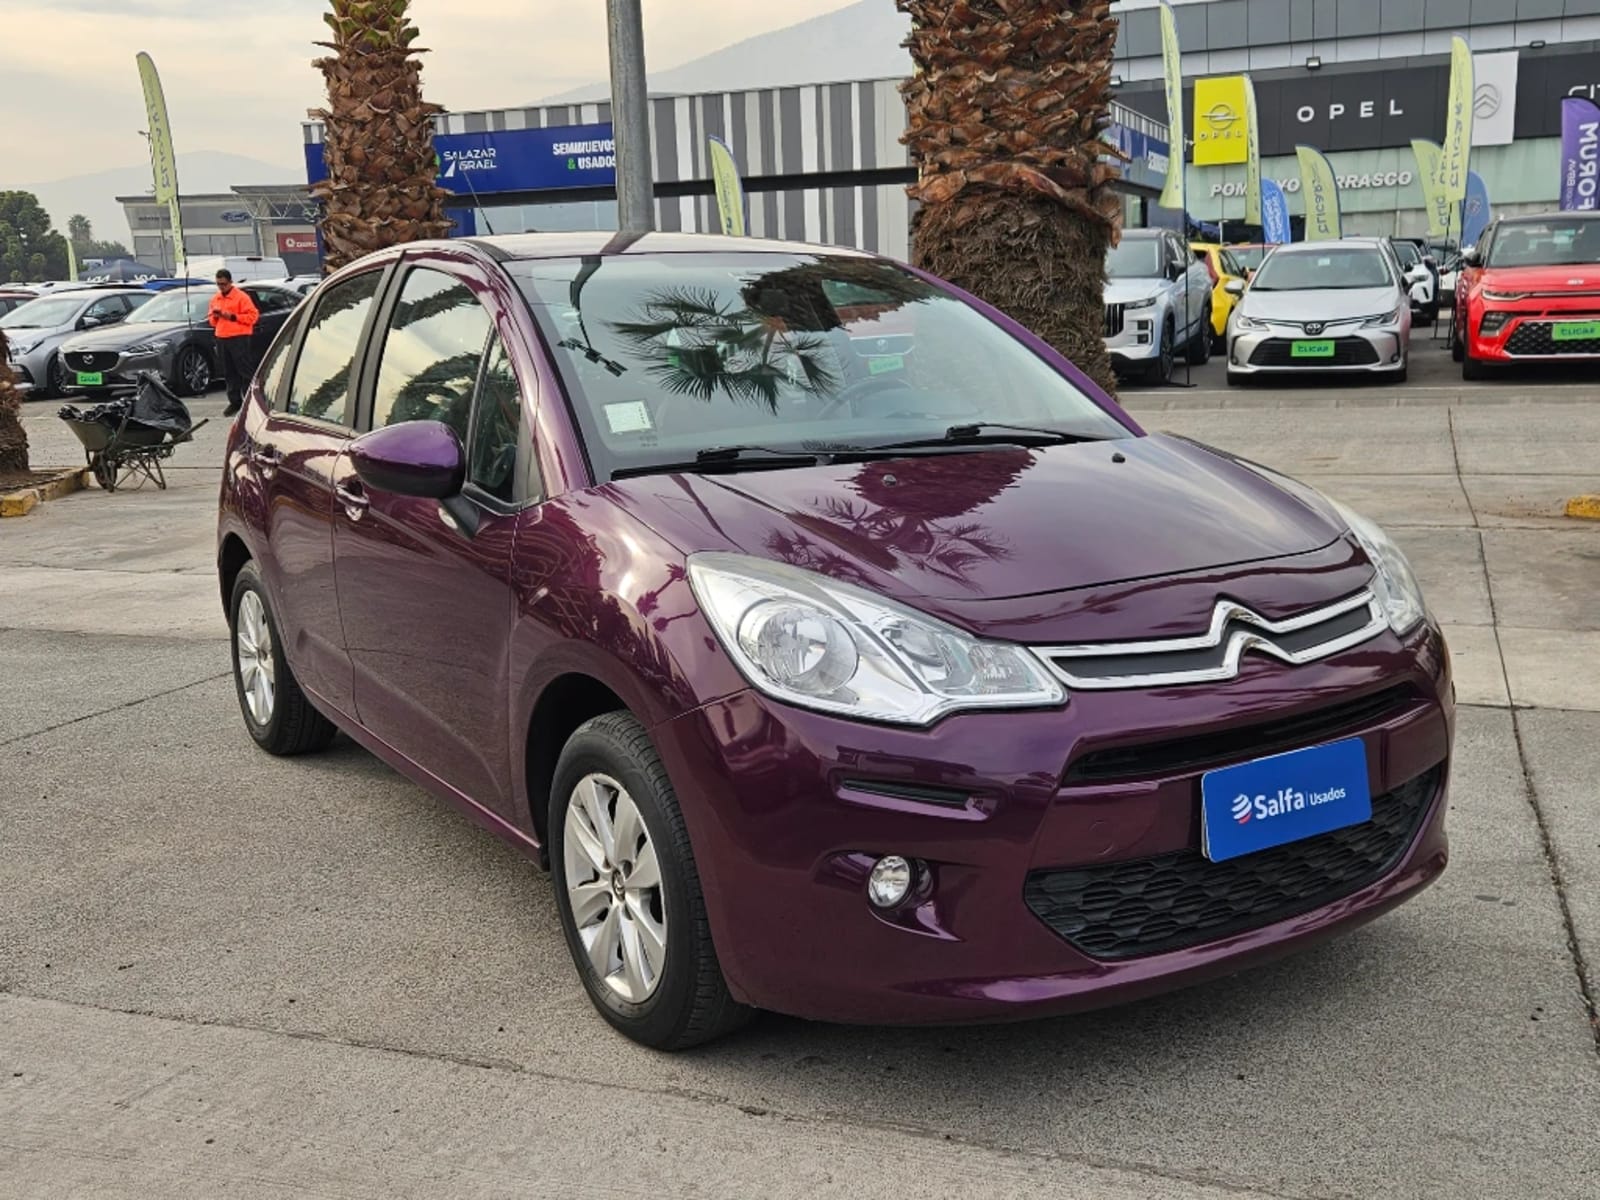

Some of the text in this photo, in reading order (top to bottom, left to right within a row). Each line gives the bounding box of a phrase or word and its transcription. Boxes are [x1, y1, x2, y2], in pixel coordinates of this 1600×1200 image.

[1296, 99, 1403, 122] OPEL
[1200, 129, 1242, 139] OPEL
[443, 148, 497, 160] SALAZAR
[459, 159, 497, 170] ISRAEL
[567, 158, 576, 170] &
[1210, 171, 1412, 197] POMYO RRASCO
[1254, 787, 1346, 819] Salfa Usados
